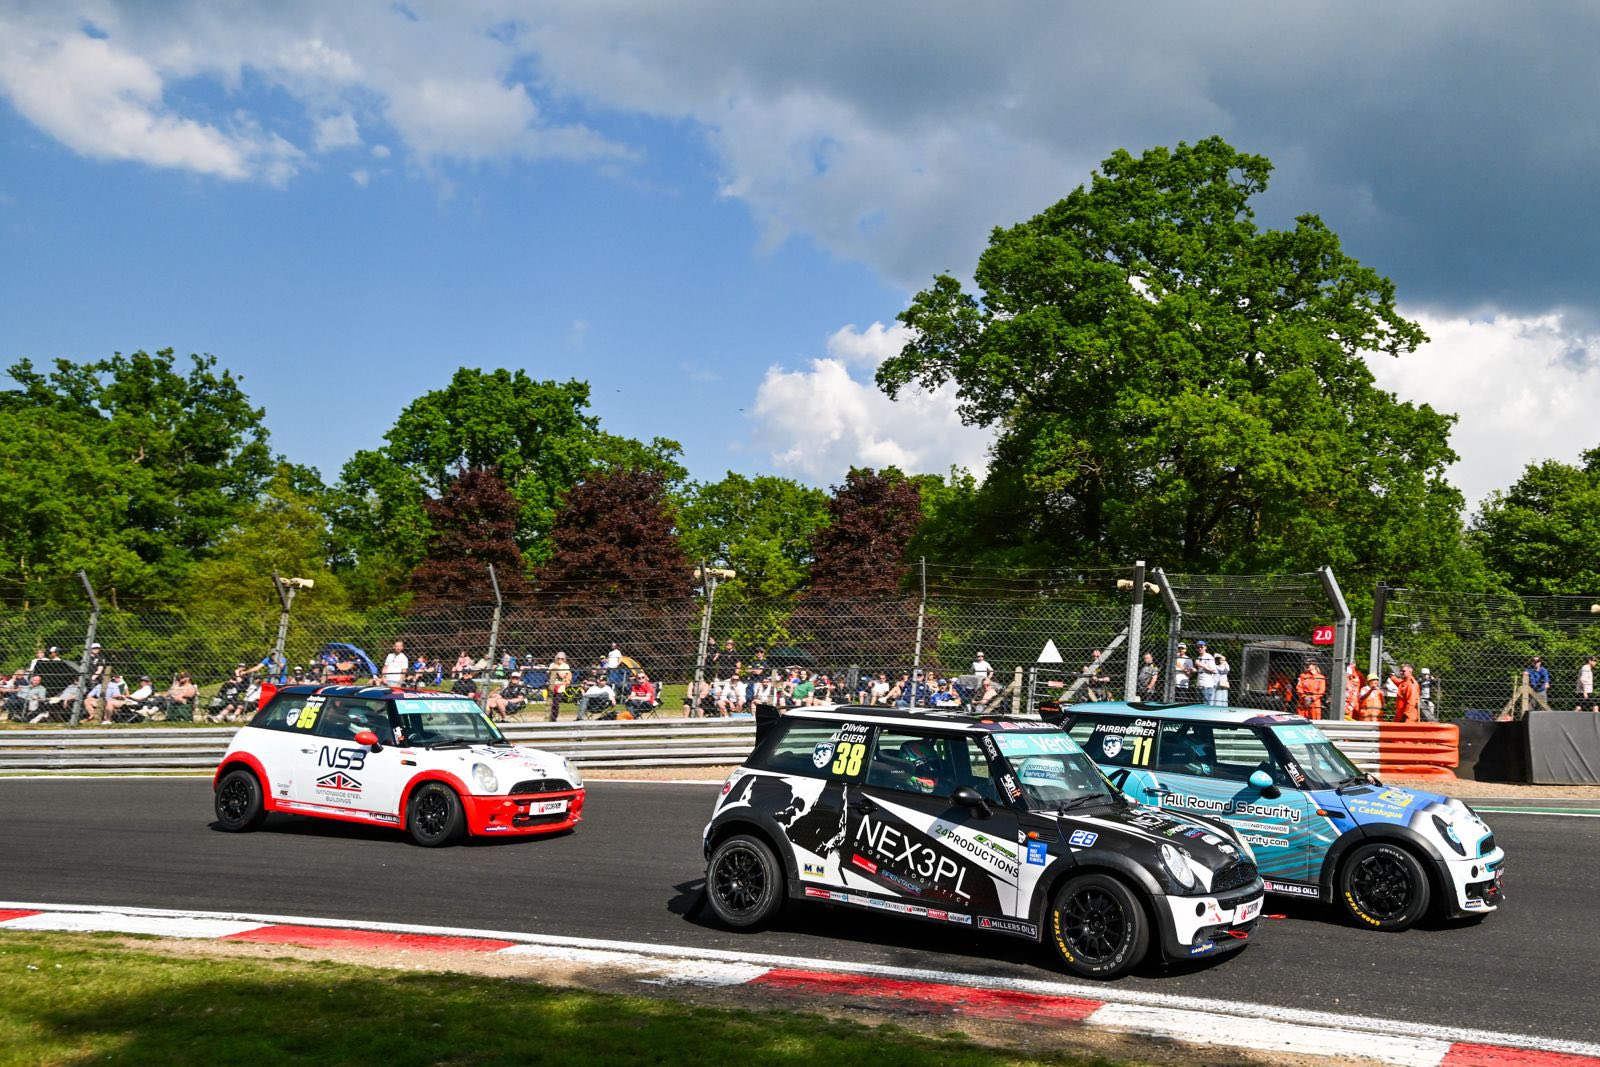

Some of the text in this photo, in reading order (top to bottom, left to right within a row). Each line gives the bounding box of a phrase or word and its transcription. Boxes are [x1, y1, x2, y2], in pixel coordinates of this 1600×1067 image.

[1315, 630, 1332, 641] 2.0
[296, 706, 320, 729] 95
[841, 723, 870, 734] Olivier
[1135, 718, 1158, 729] Gabe
[830, 732, 867, 744] ALGIERI
[1095, 724, 1156, 737] FAIRBROTHER
[318, 745, 367, 771] NSB
[832, 742, 866, 776] 38
[1131, 736, 1153, 767] 11
[1164, 793, 1300, 822] All Round Security
[1070, 830, 1097, 847] 28
[853, 841, 896, 868] GLOBAL
[856, 814, 971, 900] NEX3PL
[903, 869, 970, 907] LOGISTICS
[1273, 883, 1318, 895] MILLERS OILS
[991, 920, 1036, 935] MILLERS OILS
[1053, 910, 1075, 962] GOODYEAR
